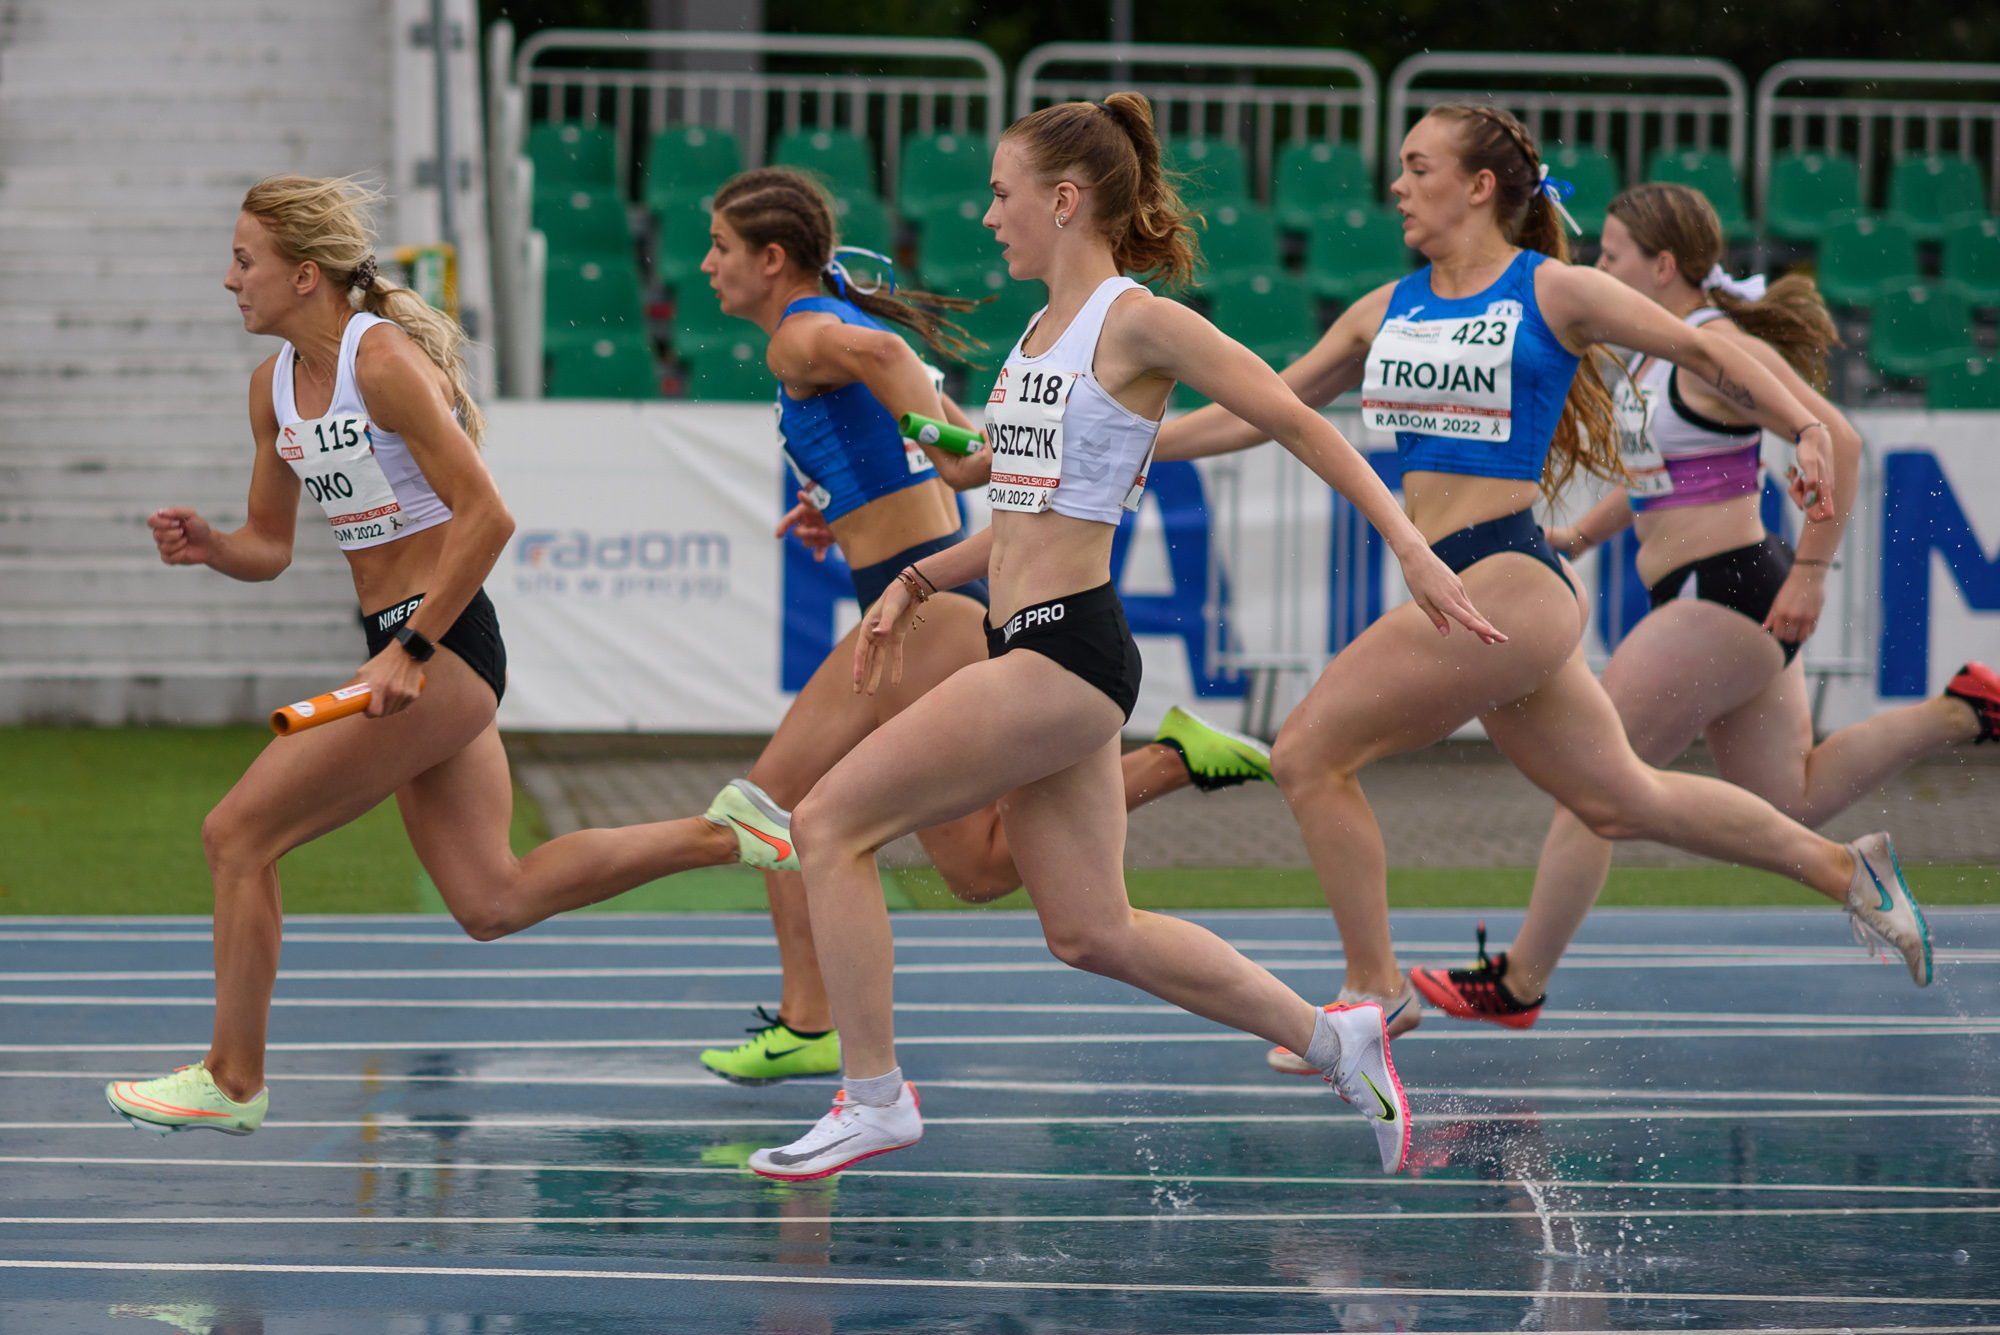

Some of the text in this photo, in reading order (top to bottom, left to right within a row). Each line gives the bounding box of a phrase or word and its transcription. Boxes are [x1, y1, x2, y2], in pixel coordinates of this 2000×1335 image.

[1451, 320, 1507, 346] 423
[1018, 371, 1063, 406] 118
[1379, 359, 1496, 394] TROJAN
[314, 419, 359, 452] 115
[1375, 413, 1481, 434] RADOM 2022
[1018, 475, 1042, 486] POLSKI
[1042, 479, 1058, 487] U20
[1007, 489, 1035, 506] 2022
[356, 508, 381, 521] POLSKI
[354, 523, 385, 540] 2022
[379, 604, 406, 632] NIKE
[1003, 603, 1065, 644] NIKE PRO
